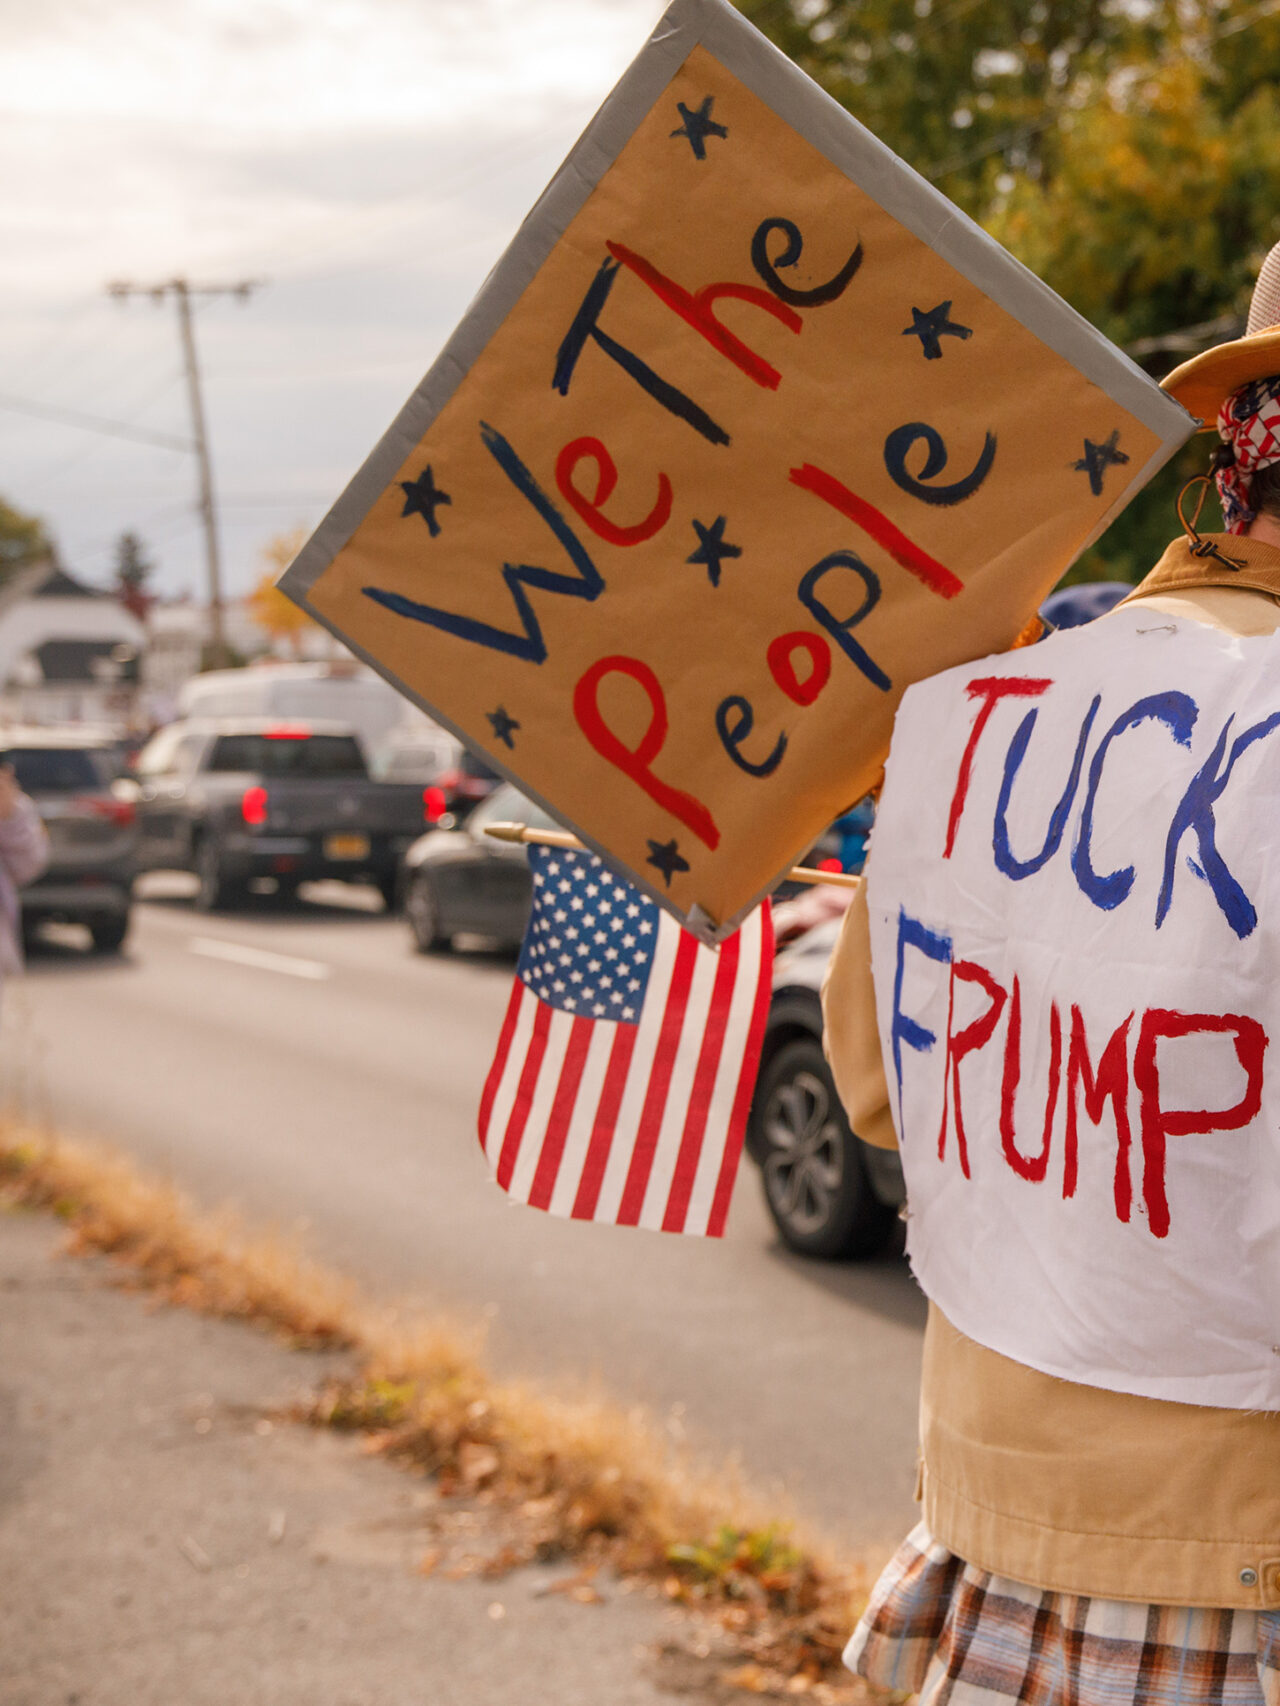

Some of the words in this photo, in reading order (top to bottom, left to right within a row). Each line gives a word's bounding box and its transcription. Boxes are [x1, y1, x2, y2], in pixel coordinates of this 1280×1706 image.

[361, 420, 673, 664] We
[552, 216, 864, 447] The
[573, 421, 998, 851] People
[891, 904, 1270, 1239] FRUMP
